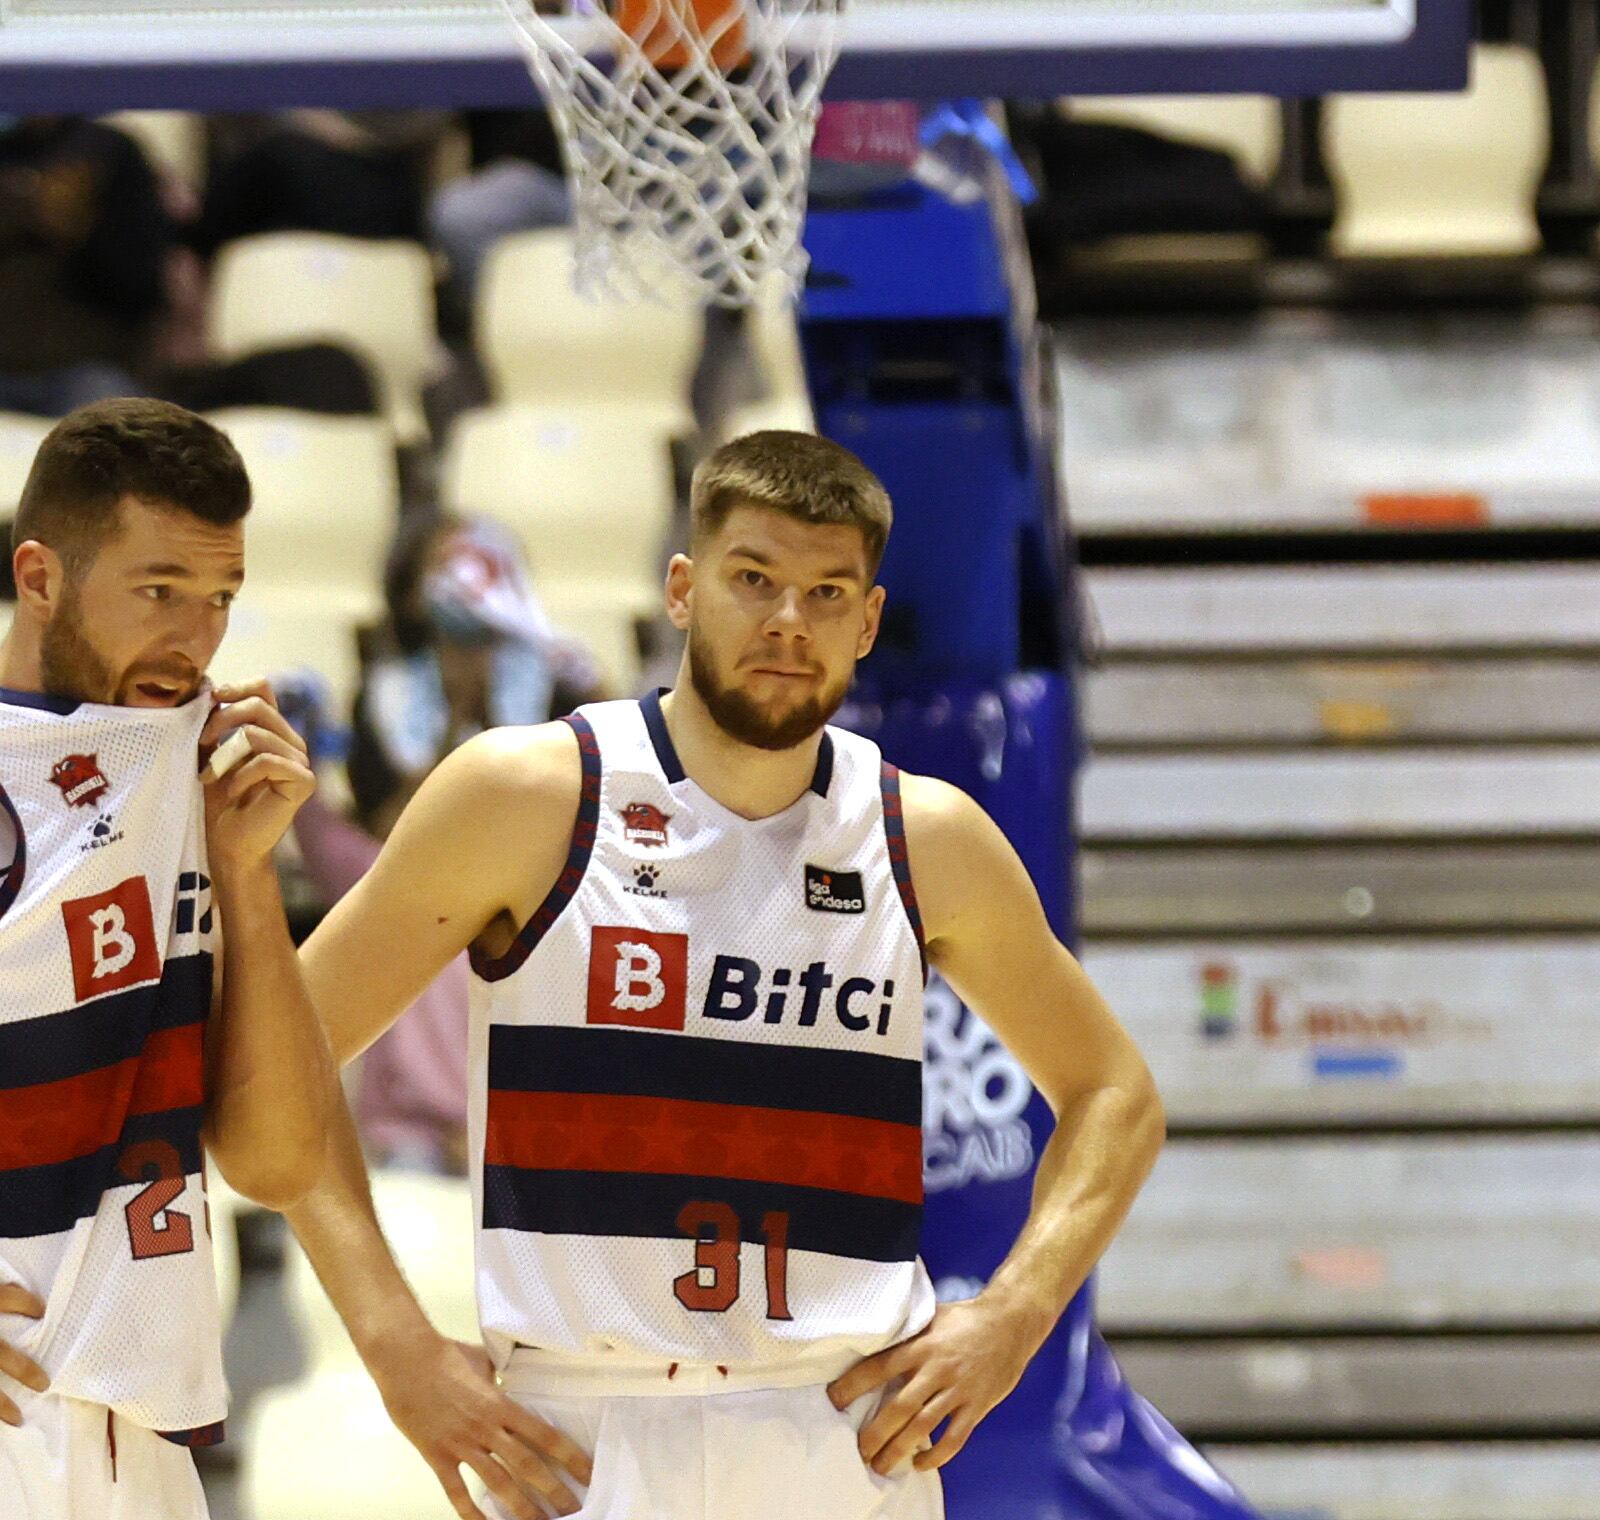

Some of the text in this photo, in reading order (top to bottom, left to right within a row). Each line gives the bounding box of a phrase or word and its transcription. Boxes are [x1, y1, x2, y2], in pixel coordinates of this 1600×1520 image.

[623, 886, 668, 899] KELME
[808, 878, 830, 895] liga
[810, 895, 862, 910] endesa
[702, 954, 894, 1036] Bitci
[117, 1138, 212, 1261] 2
[673, 1200, 794, 1321] 31
